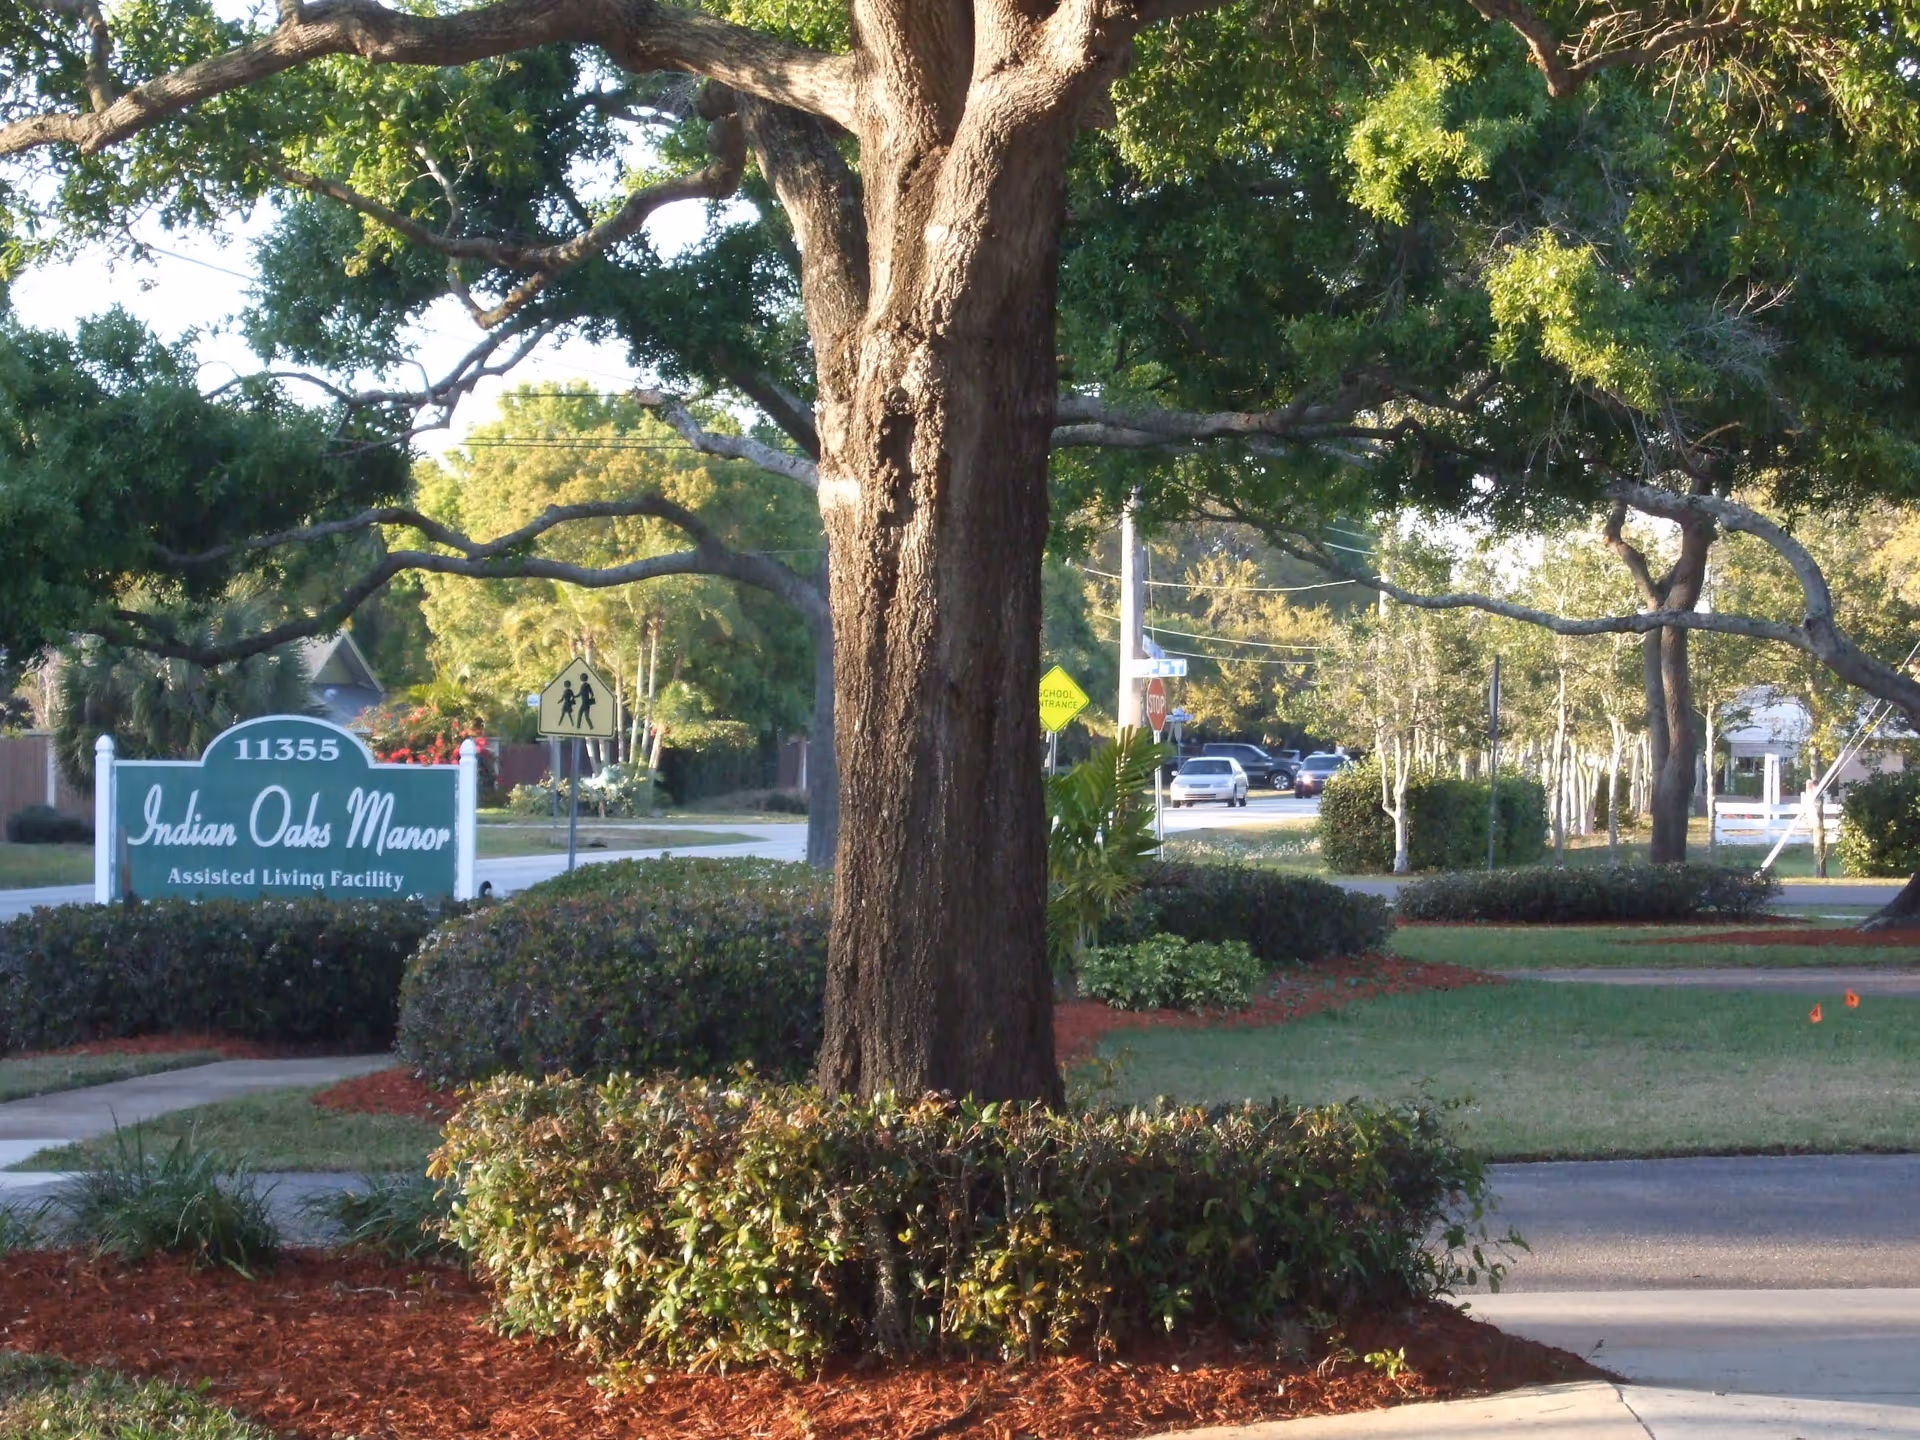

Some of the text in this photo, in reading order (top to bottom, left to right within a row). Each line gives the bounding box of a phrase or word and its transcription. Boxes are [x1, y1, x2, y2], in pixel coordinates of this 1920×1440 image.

[1039, 700, 1078, 709] NTRANCE
[1148, 695, 1165, 714] STOP
[234, 738, 339, 762] 11355
[127, 784, 450, 856] Indian Oaks Manor
[167, 867, 404, 892] Assisted Living Facility
